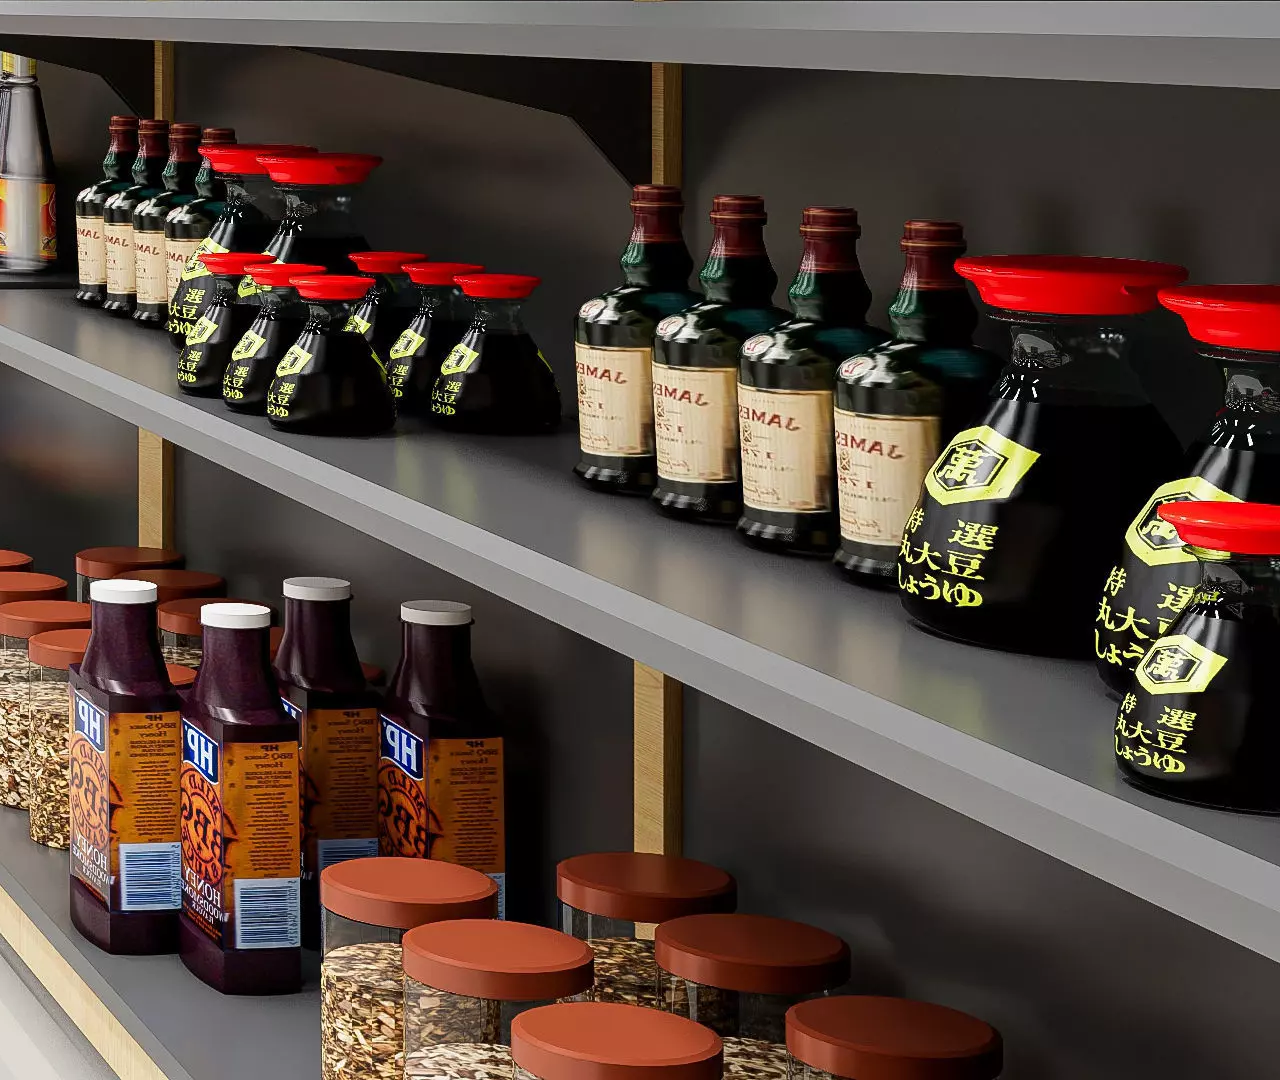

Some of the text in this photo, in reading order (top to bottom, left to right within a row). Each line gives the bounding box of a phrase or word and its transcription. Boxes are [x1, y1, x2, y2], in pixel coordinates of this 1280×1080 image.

[169, 301, 199, 320] 大豆
[177, 361, 197, 372] 大豆
[224, 375, 244, 388] 大豆
[267, 392, 290, 406] 大豆
[433, 390, 457, 405] 大豆
[898, 533, 986, 580] 丸大豆
[897, 562, 984, 607] しょうゆ
[1115, 712, 1188, 754] 丸大豆
[1114, 734, 1187, 774] しょうゆ
